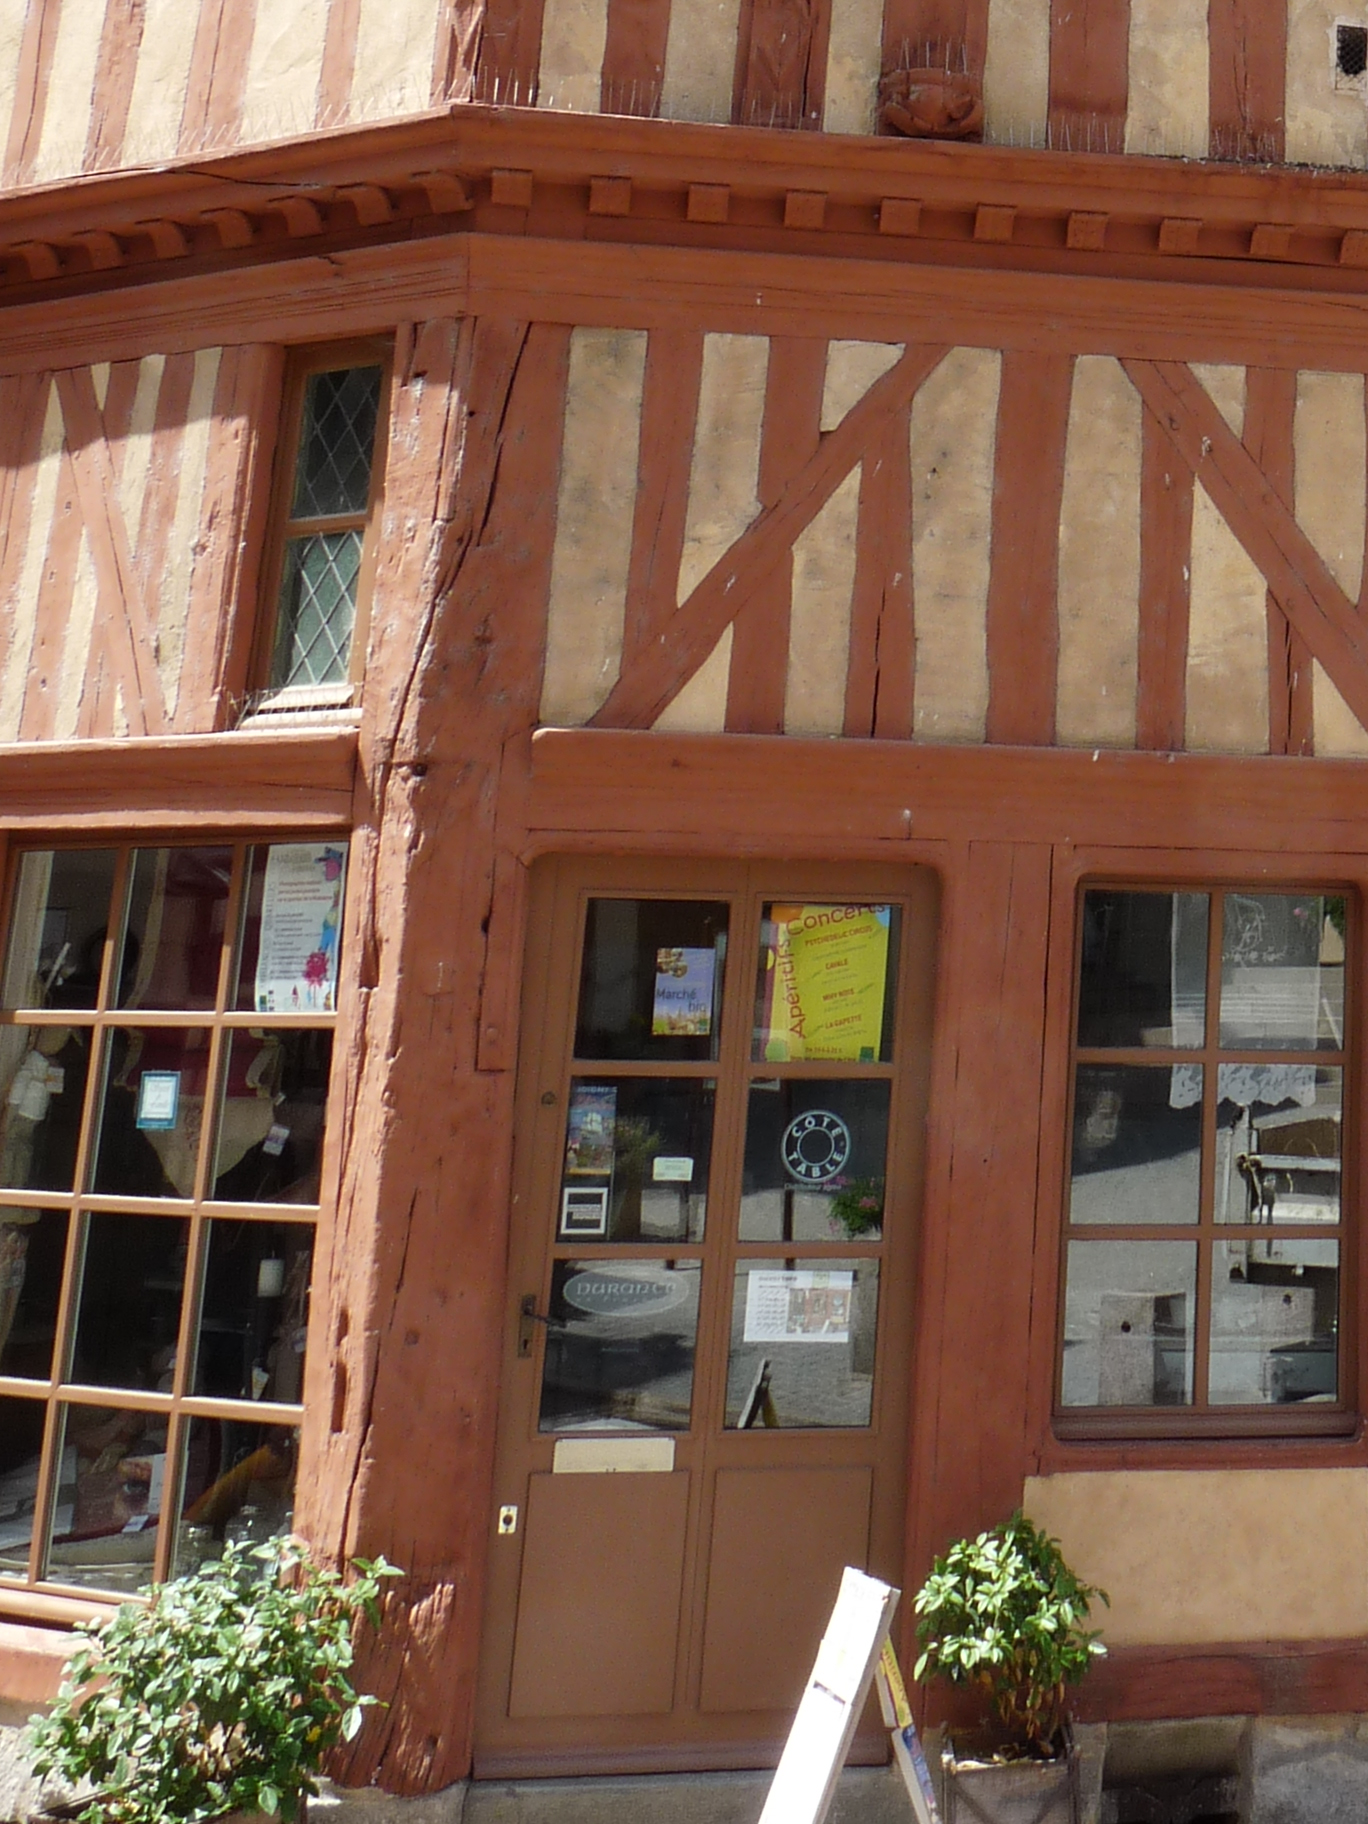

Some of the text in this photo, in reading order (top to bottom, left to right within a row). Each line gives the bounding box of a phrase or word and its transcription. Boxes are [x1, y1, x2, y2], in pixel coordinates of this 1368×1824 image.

[786, 903, 885, 937] Concerts
[656, 987, 697, 1000] Marché
[778, 939, 806, 1040] Apéritifs
[688, 1000, 707, 1012] bio
[787, 1151, 844, 1178] TABLE
